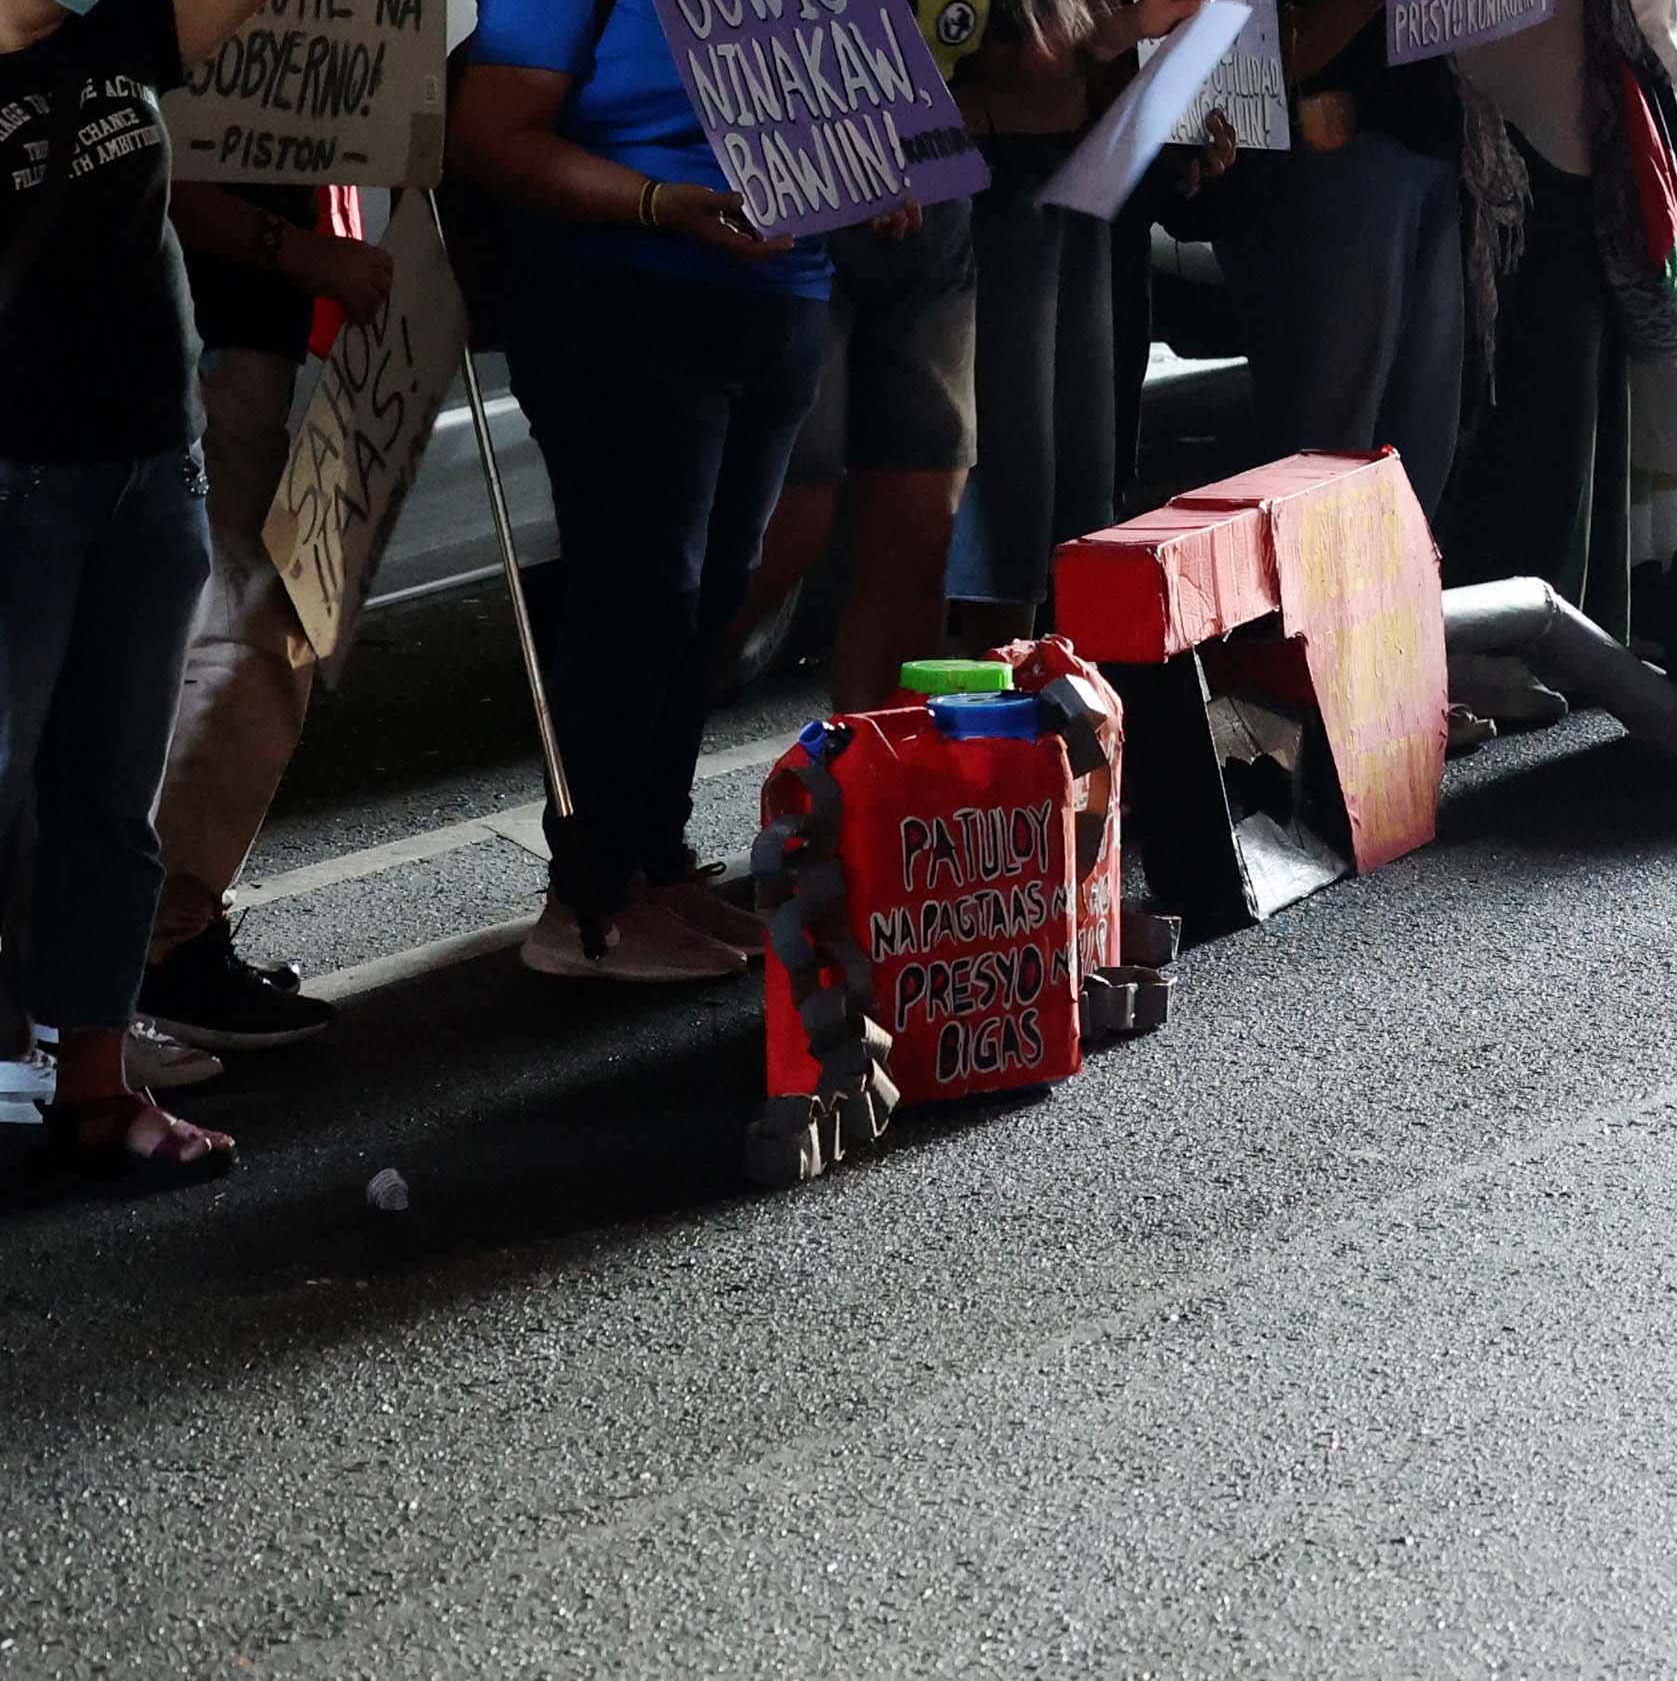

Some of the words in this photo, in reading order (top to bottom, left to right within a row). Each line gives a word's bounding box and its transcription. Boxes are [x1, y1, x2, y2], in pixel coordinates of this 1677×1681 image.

[687, 7, 933, 130] NINAKAW,
[220, 125, 337, 171] PISTON
[900, 799, 1053, 892] PATULOY
[870, 906, 916, 963] NA
[920, 879, 1047, 954] PAGTAAS
[895, 943, 1045, 1033] PRESYO
[936, 1008, 1045, 1085] BIGAS
